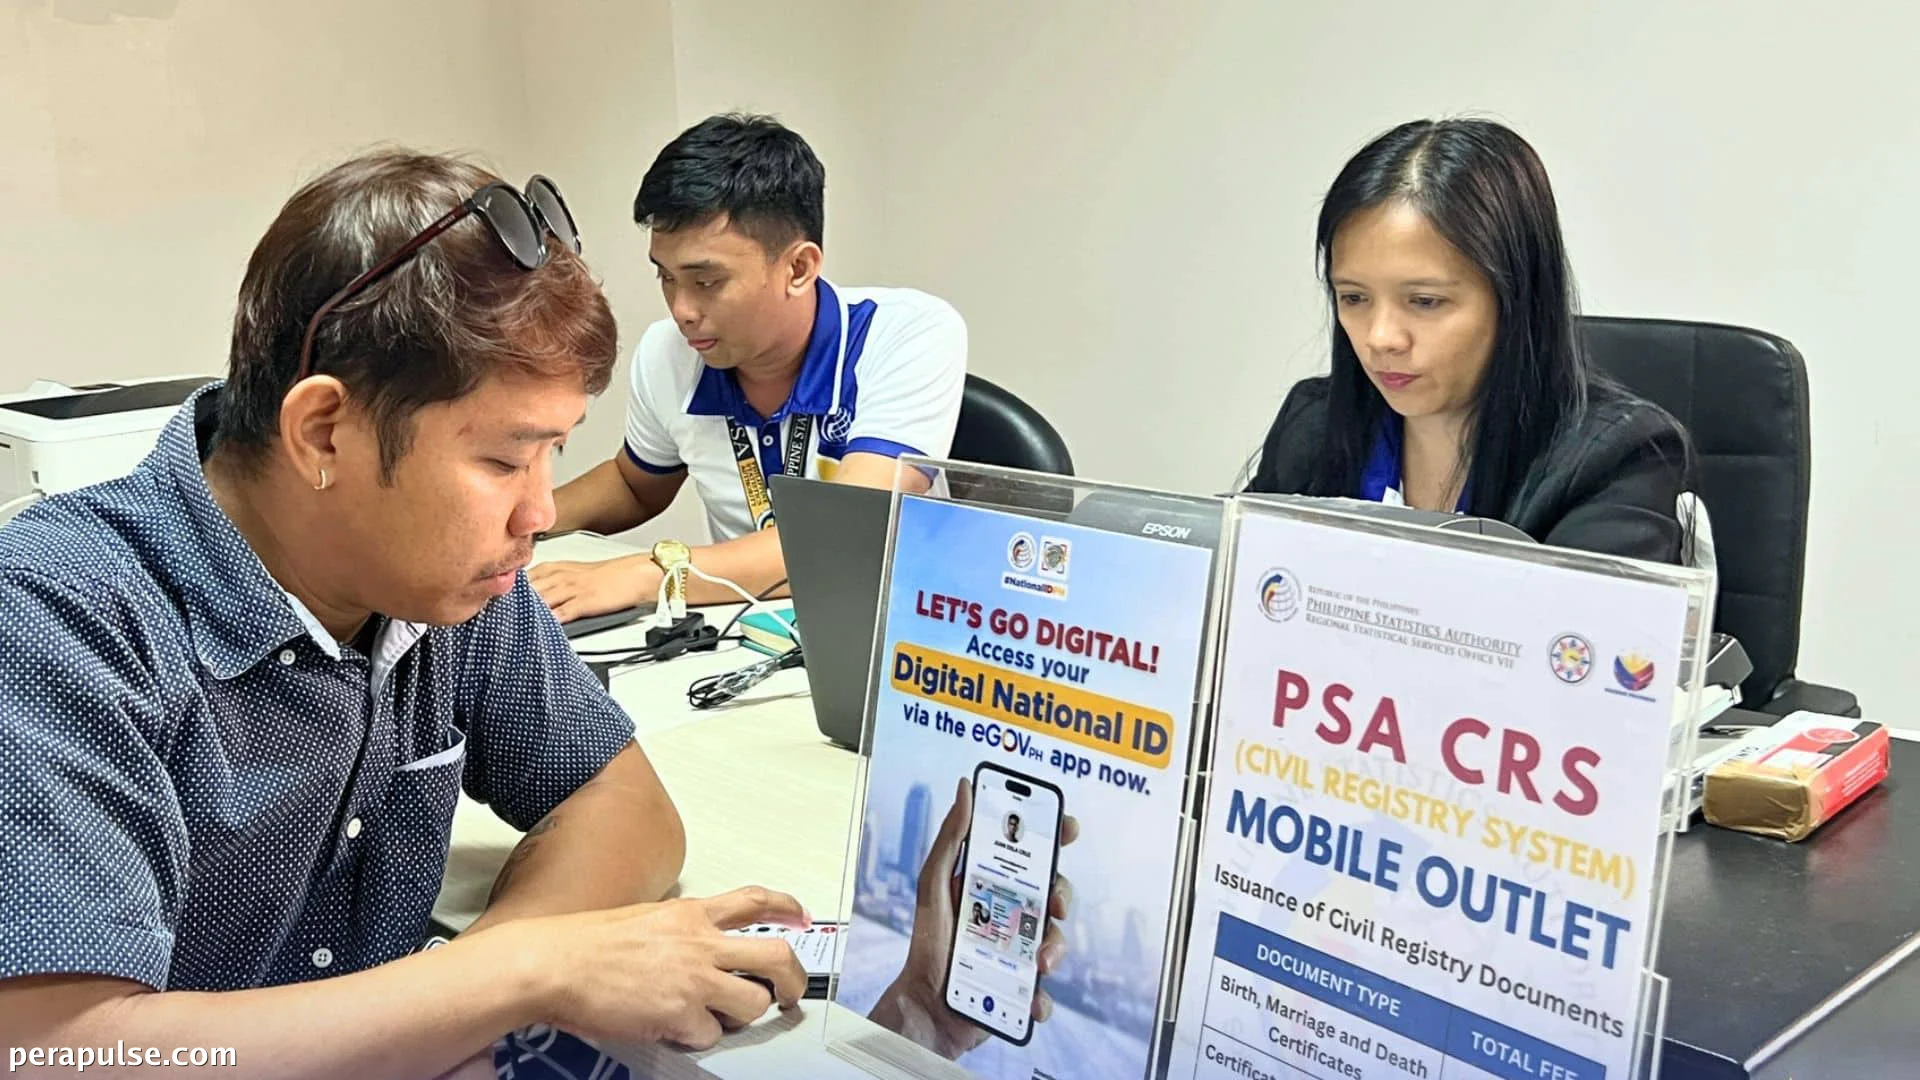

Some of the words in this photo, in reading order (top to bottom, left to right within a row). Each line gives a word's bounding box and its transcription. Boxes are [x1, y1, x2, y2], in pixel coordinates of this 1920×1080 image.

[727, 416, 751, 458] SA
[1141, 522, 1192, 539] EPSON
[966, 635, 1034, 670] Access
[1041, 657, 1090, 685] your
[990, 608, 1029, 640] GO
[1036, 618, 1160, 673] DIGITAL!
[1306, 613, 1350, 632] REGIONAL
[1353, 624, 1408, 645] STATISTICAL
[1411, 637, 1455, 655] SERVICES
[1458, 647, 1494, 665] OFFICE
[1307, 598, 1371, 621] PHILIPPINE
[1375, 610, 1441, 639] STATISTICS
[1445, 628, 1524, 655] AUTHORITY
[893, 653, 984, 704] Digital
[992, 679, 1124, 745] National
[1132, 719, 1169, 756] ID
[903, 704, 930, 728] via
[935, 711, 965, 738] the
[1050, 748, 1091, 780] app
[1099, 764, 1151, 796] now.
[1272, 669, 1406, 764] PSA
[1440, 717, 1602, 816] CRS
[1235, 738, 1315, 792] (CIVIL
[1323, 764, 1475, 836] REGISTRY
[1481, 816, 1636, 900] SYSTEM)
[1225, 790, 1403, 893] MOBILE
[1415, 855, 1631, 970] OUTLET
[1214, 864, 1299, 915] Issuance
[1303, 901, 1327, 922] of
[1329, 910, 1375, 944] Civil
[1381, 927, 1473, 983] Registry
[1479, 964, 1625, 1038] Documents
[1257, 943, 1354, 997] DOCUMENT
[1357, 984, 1402, 1017] TYPE
[1220, 975, 1261, 1010] Birth,
[1265, 995, 1336, 1039] Marriage
[1339, 1030, 1371, 1054] and
[1375, 1043, 1428, 1080] Death
[1268, 1026, 1363, 1080] Certificates
[1471, 1031, 1534, 1074] TOTAL
